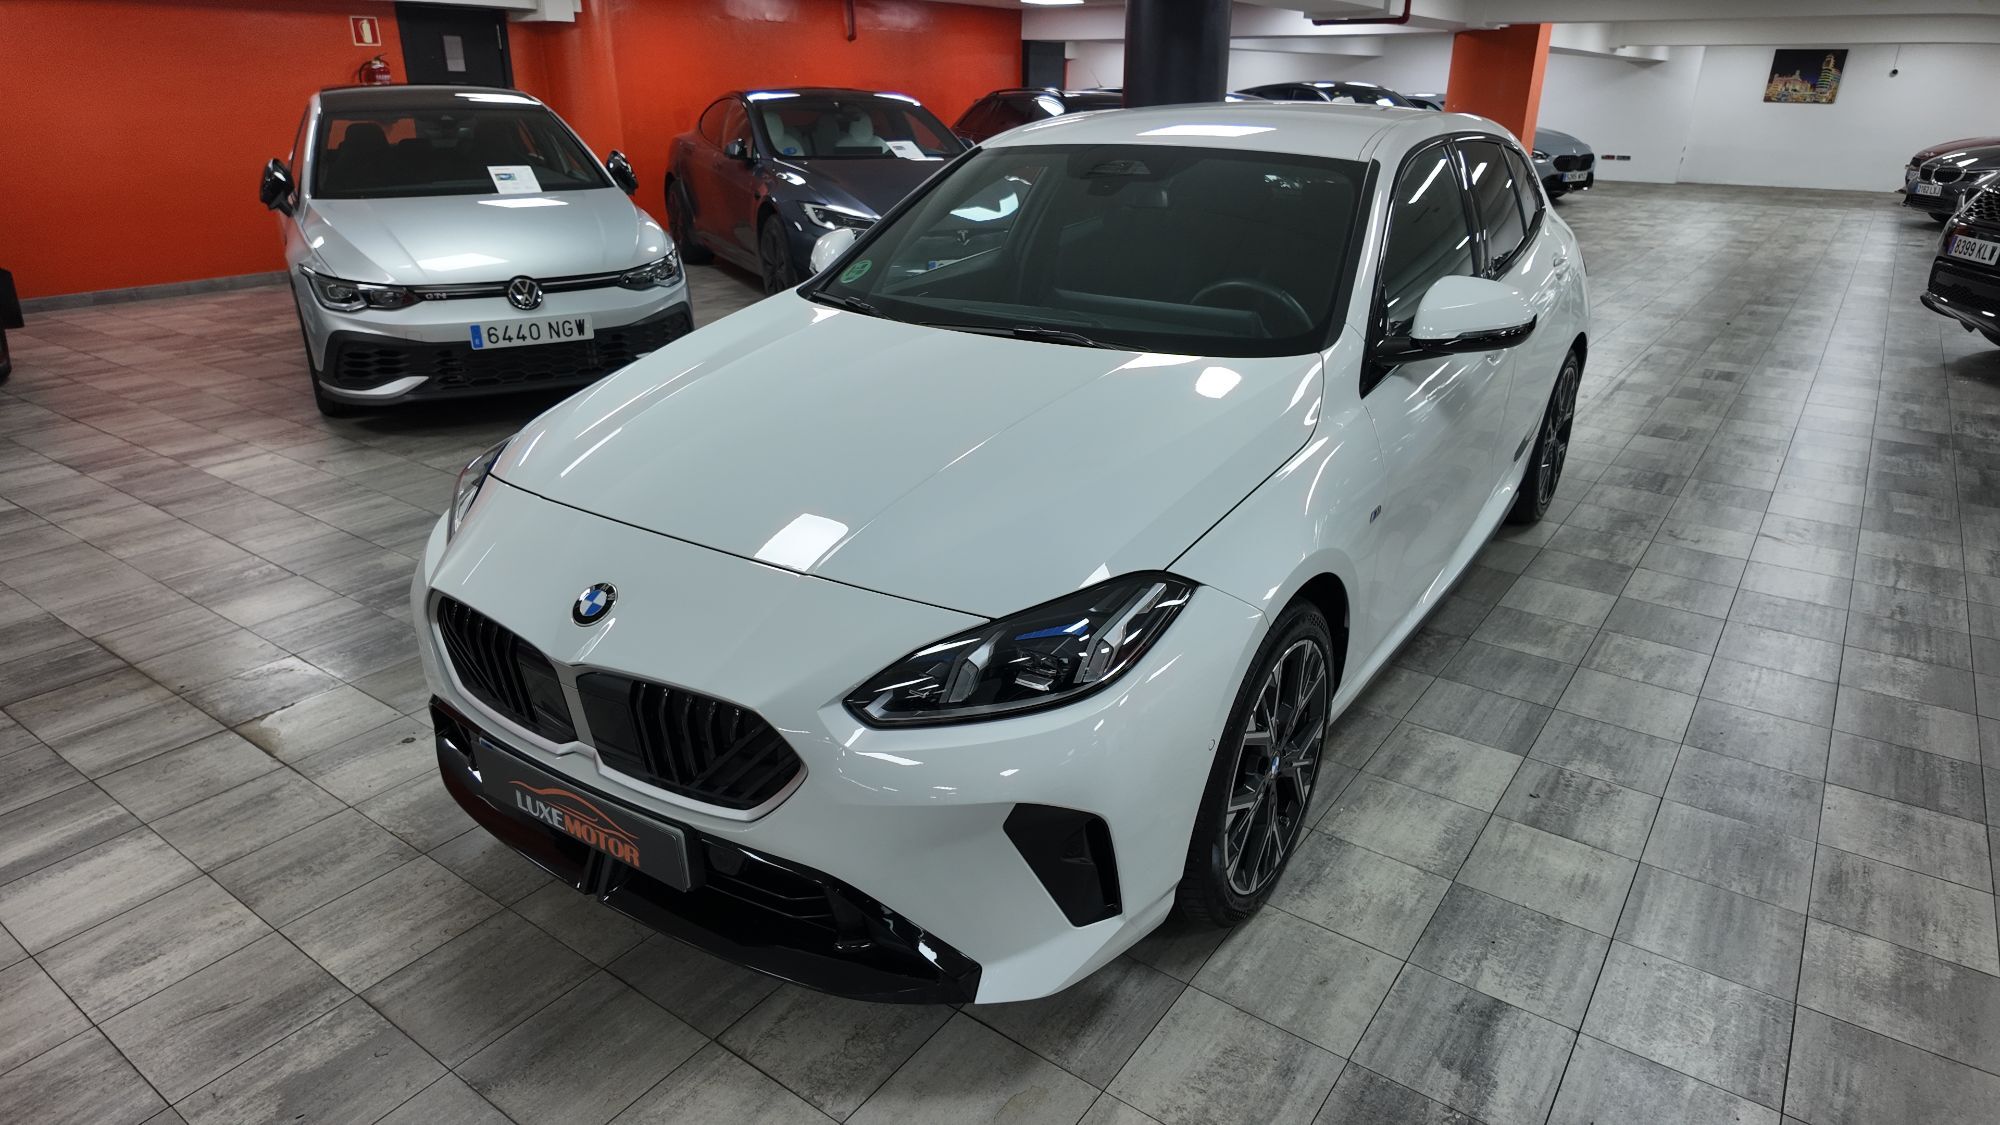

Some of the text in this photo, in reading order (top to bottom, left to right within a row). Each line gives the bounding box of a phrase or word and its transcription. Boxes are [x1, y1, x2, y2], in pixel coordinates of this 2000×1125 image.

[1954, 239, 1977, 257] 8399
[486, 318, 585, 344] 6440 NGW
